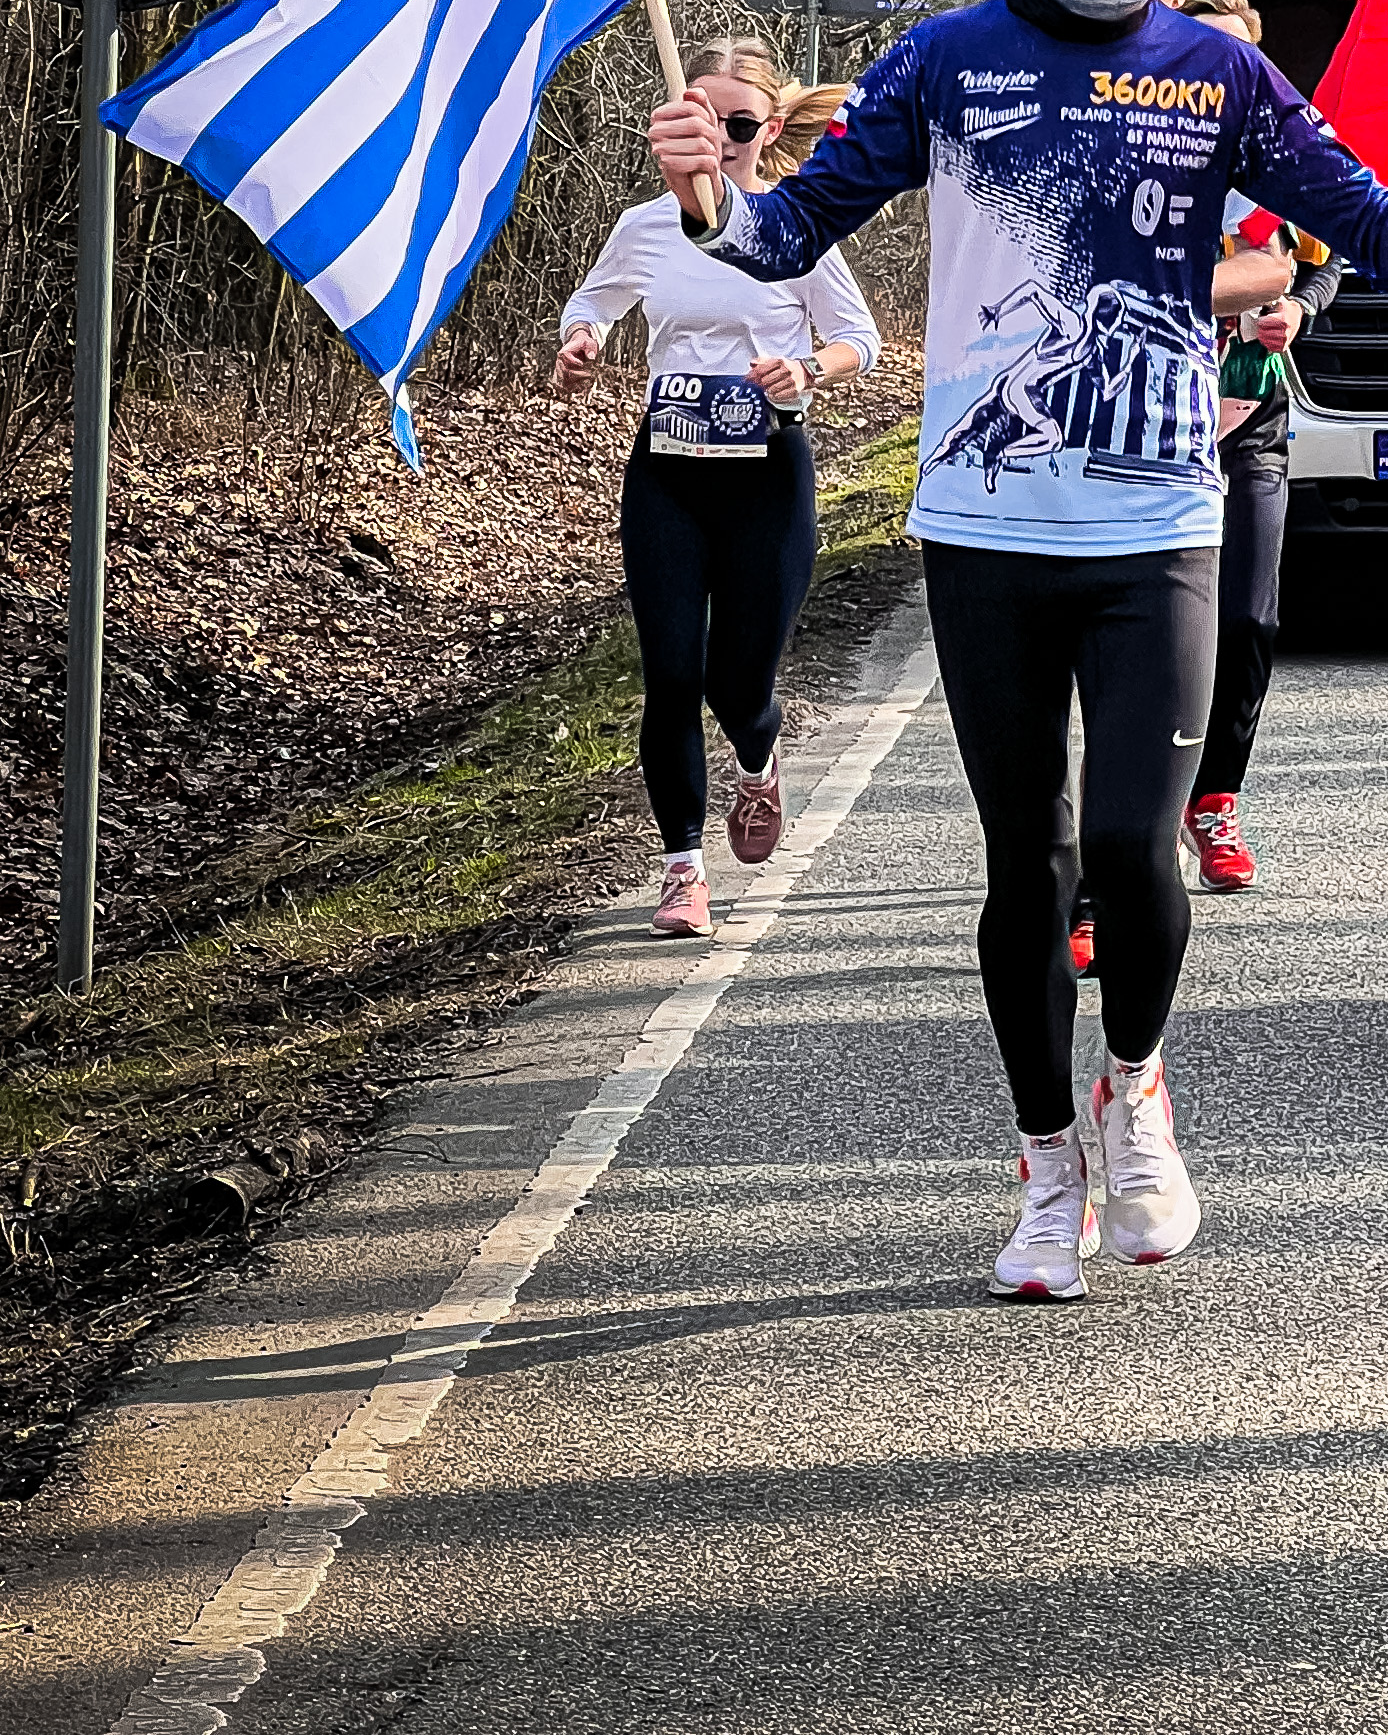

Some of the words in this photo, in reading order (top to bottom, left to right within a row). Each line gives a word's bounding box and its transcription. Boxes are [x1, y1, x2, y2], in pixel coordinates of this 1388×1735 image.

[1089, 71, 1225, 117] 3600KM
[961, 101, 1041, 134] Milwaukee
[1060, 107, 1112, 123] POLAND
[1125, 111, 1169, 128] GREECE
[1177, 116, 1221, 135] POLAND
[1146, 147, 1170, 167] FOR
[658, 375, 703, 400] 100
